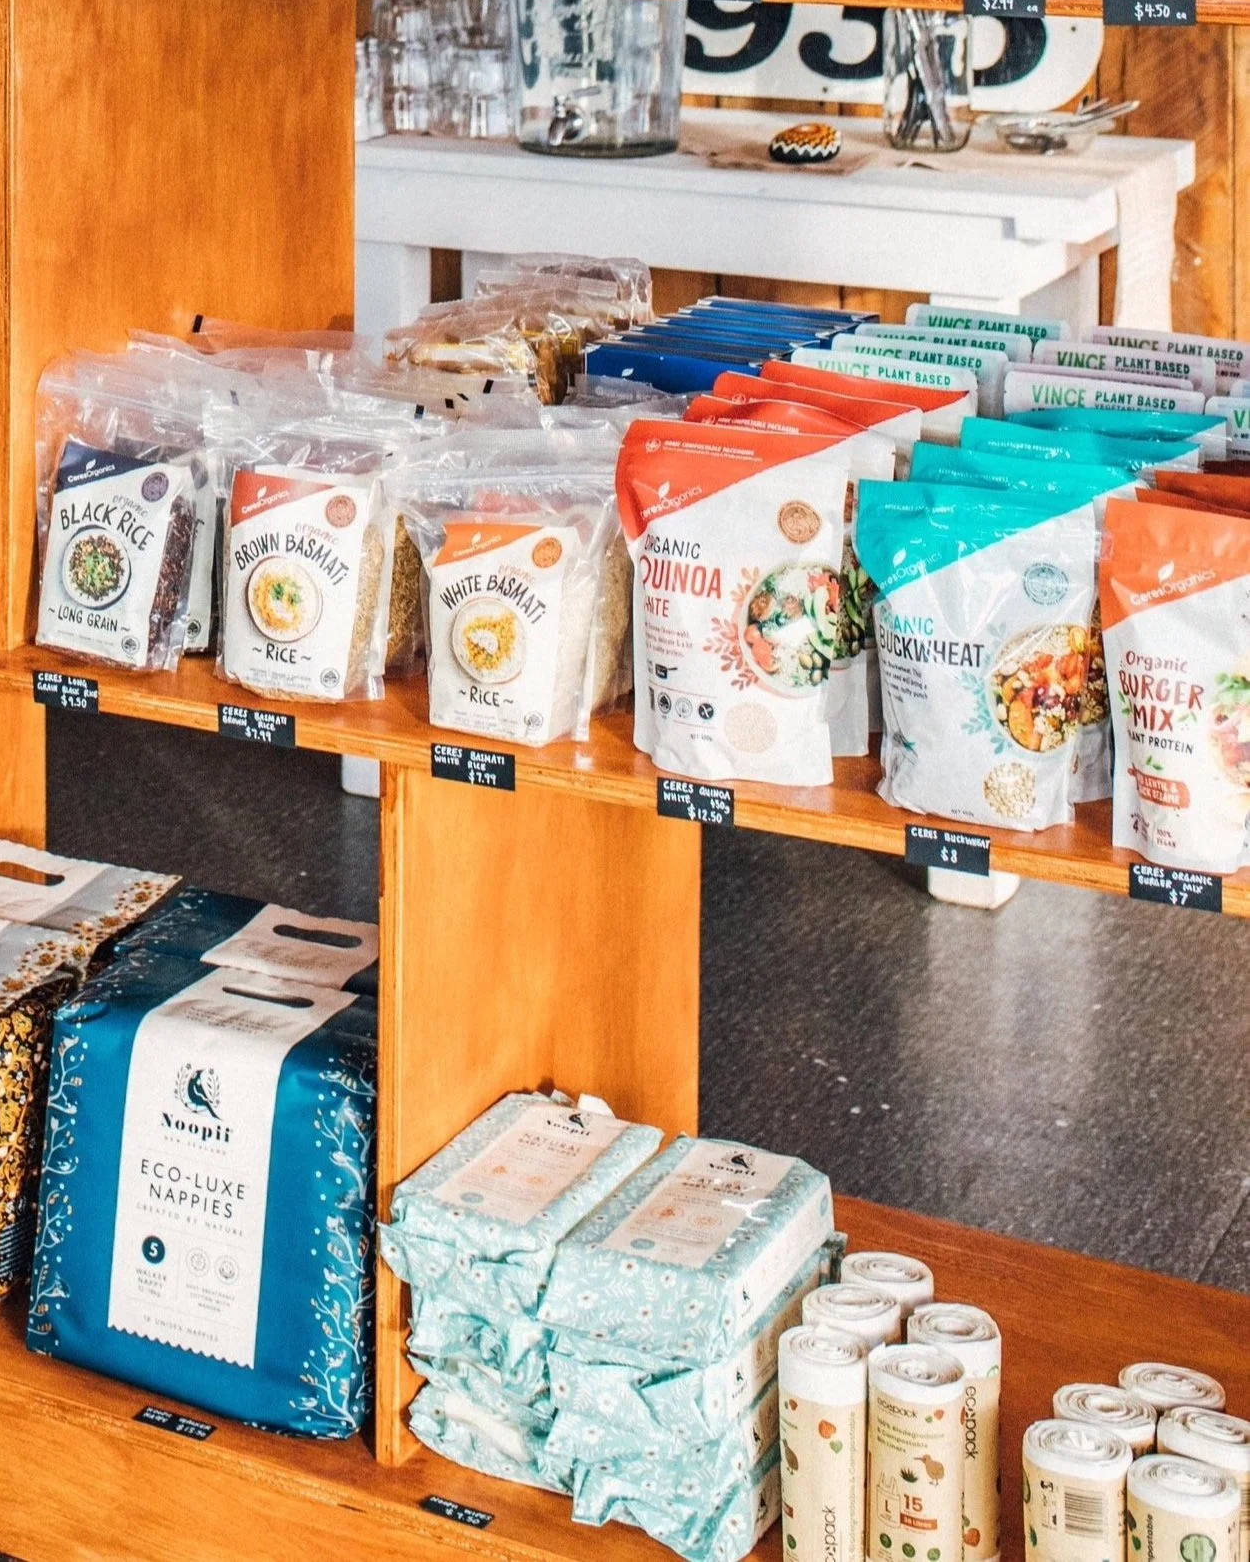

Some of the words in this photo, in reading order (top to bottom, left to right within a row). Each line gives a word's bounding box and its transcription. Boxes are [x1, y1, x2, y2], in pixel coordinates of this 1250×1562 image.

[1134, 2, 1171, 20] $4.50
[1057, 350, 1107, 371] VINCE
[1115, 356, 1151, 371] PLANT
[1155, 360, 1190, 375] BASED
[1032, 384, 1086, 408] VINCE
[1095, 391, 1132, 405] PLANT
[1137, 395, 1176, 411] BASED
[67, 463, 116, 483] CeresOrganics
[60, 502, 113, 530] BLACK
[234, 533, 281, 571] BROWN
[1130, 568, 1217, 607] CeresOrganics
[57, 605, 82, 623] LONG
[878, 625, 985, 668] BUCKWHEAT
[1126, 650, 1190, 674] Organic
[38, 673, 62, 683] CERES
[68, 677, 87, 688] LONG
[1119, 670, 1205, 710] BURGER
[60, 695, 87, 709] $9.50
[222, 706, 248, 717] CERES
[254, 712, 287, 725] BASMATI
[1133, 701, 1175, 732] MIX
[245, 727, 272, 742] $7.99
[1148, 735, 1195, 754] PROTEIN
[434, 745, 463, 759] CERES
[470, 751, 505, 766] BASMATI
[468, 770, 497, 785] $7.99
[663, 780, 694, 793] CERES
[699, 787, 731, 800] QUINOA
[687, 803, 723, 823] $12.50
[911, 826, 938, 839] CERES
[944, 833, 991, 850] BUCKWHEAT
[940, 846, 958, 863] $8
[1133, 865, 1165, 878] CERES
[1171, 871, 1212, 886] ORGANIC
[1168, 889, 1188, 906] $7
[161, 1112, 233, 1144] Noopii
[141, 1159, 247, 1201] ECO-LUXE
[149, 1183, 234, 1219] NAPPIES
[148, 1242, 159, 1258] 5
[965, 1386, 979, 1460] ecopack
[885, 1499, 891, 1513] L
[904, 1493, 923, 1512] 15
